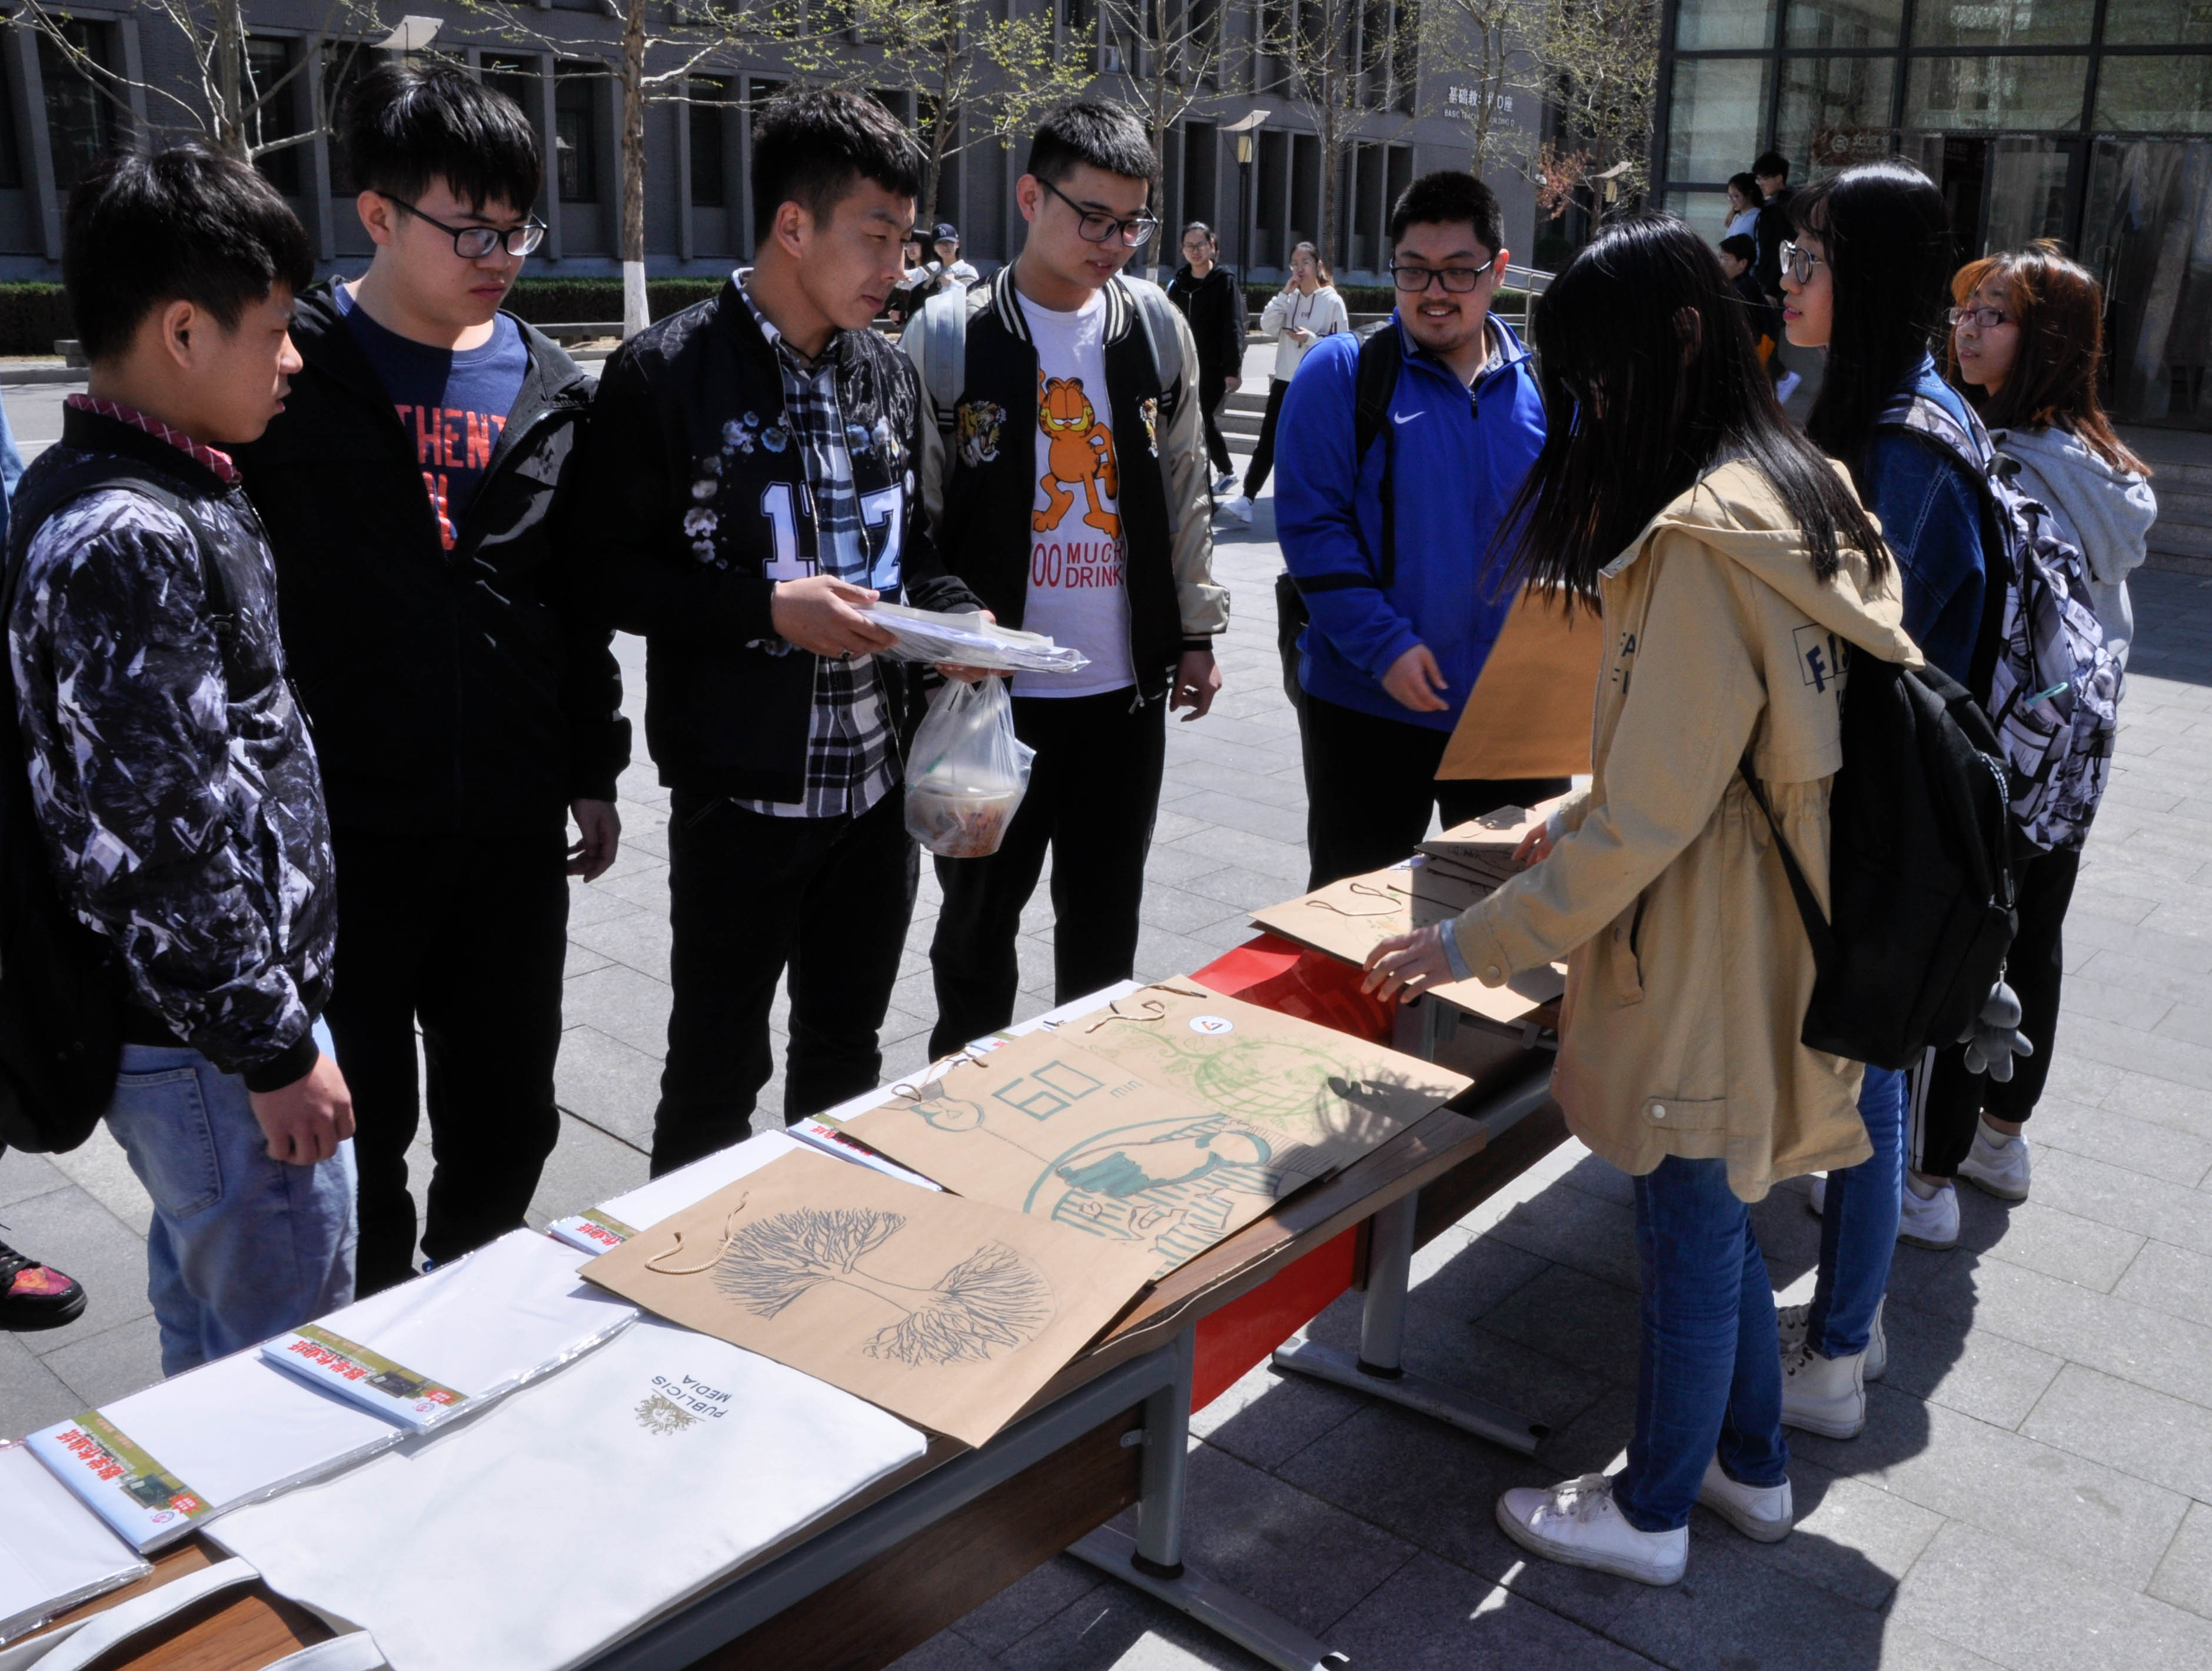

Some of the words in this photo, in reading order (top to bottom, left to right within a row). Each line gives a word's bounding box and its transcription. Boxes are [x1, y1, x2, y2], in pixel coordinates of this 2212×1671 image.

[1448, 86, 1513, 112] 基础教D座
[1067, 541, 1123, 564] MUCH
[1065, 564, 1123, 588] DRINK
[1110, 1079, 1144, 1099] min
[287, 1339, 368, 1381] 数学作业纸
[651, 1376, 729, 1418] PUBLICIS
[682, 1374, 733, 1403] MEDIA
[55, 1429, 125, 1481] 数学作业纸
